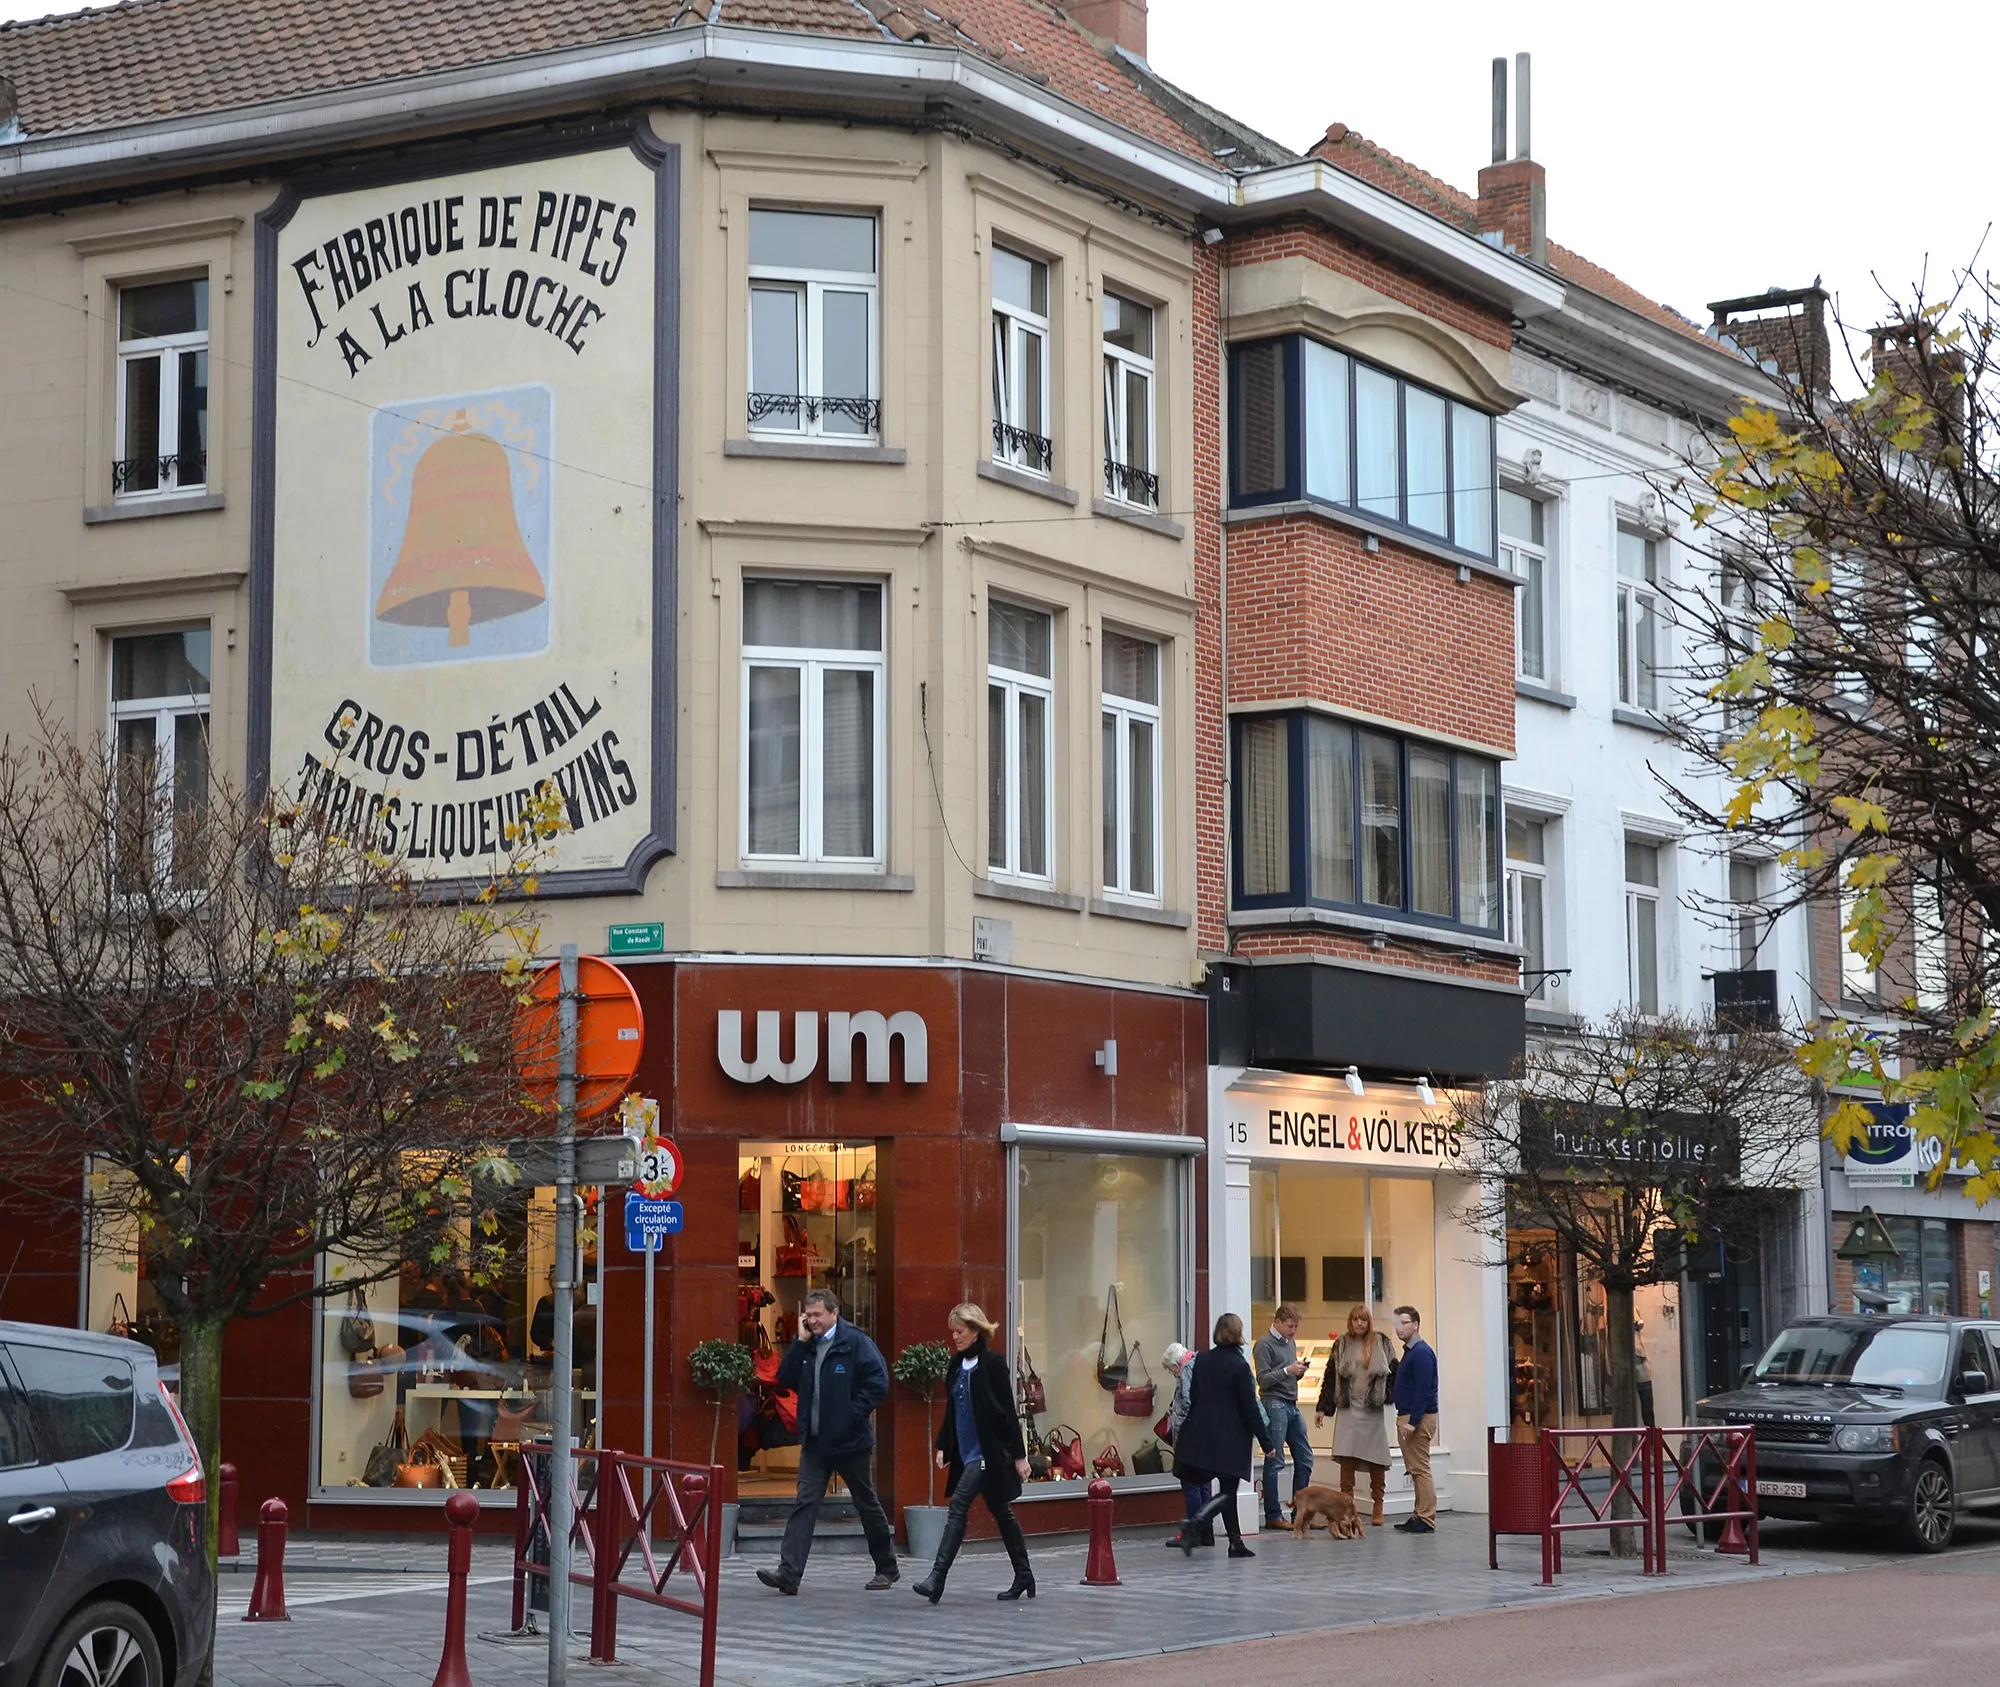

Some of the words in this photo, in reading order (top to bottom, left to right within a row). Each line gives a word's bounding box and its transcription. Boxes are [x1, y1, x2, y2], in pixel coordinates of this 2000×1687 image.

[291, 195, 464, 348] FABRIQUE
[478, 196, 523, 248] DE
[530, 190, 637, 287] PIPES
[335, 327, 373, 379] A
[370, 281, 434, 349] LA
[444, 267, 607, 355] CLOCHE
[624, 927, 648, 935] Constant
[976, 937, 988, 951] PONT
[717, 1009, 929, 1084] wm
[1228, 1121, 1248, 1144] 15
[639, 1203, 671, 1214] Excepté
[634, 1214, 678, 1224] circulation
[642, 1224, 668, 1233] locale
[1728, 1411, 1775, 1420] RANGE
[1783, 1414, 1833, 1422] ROVER
